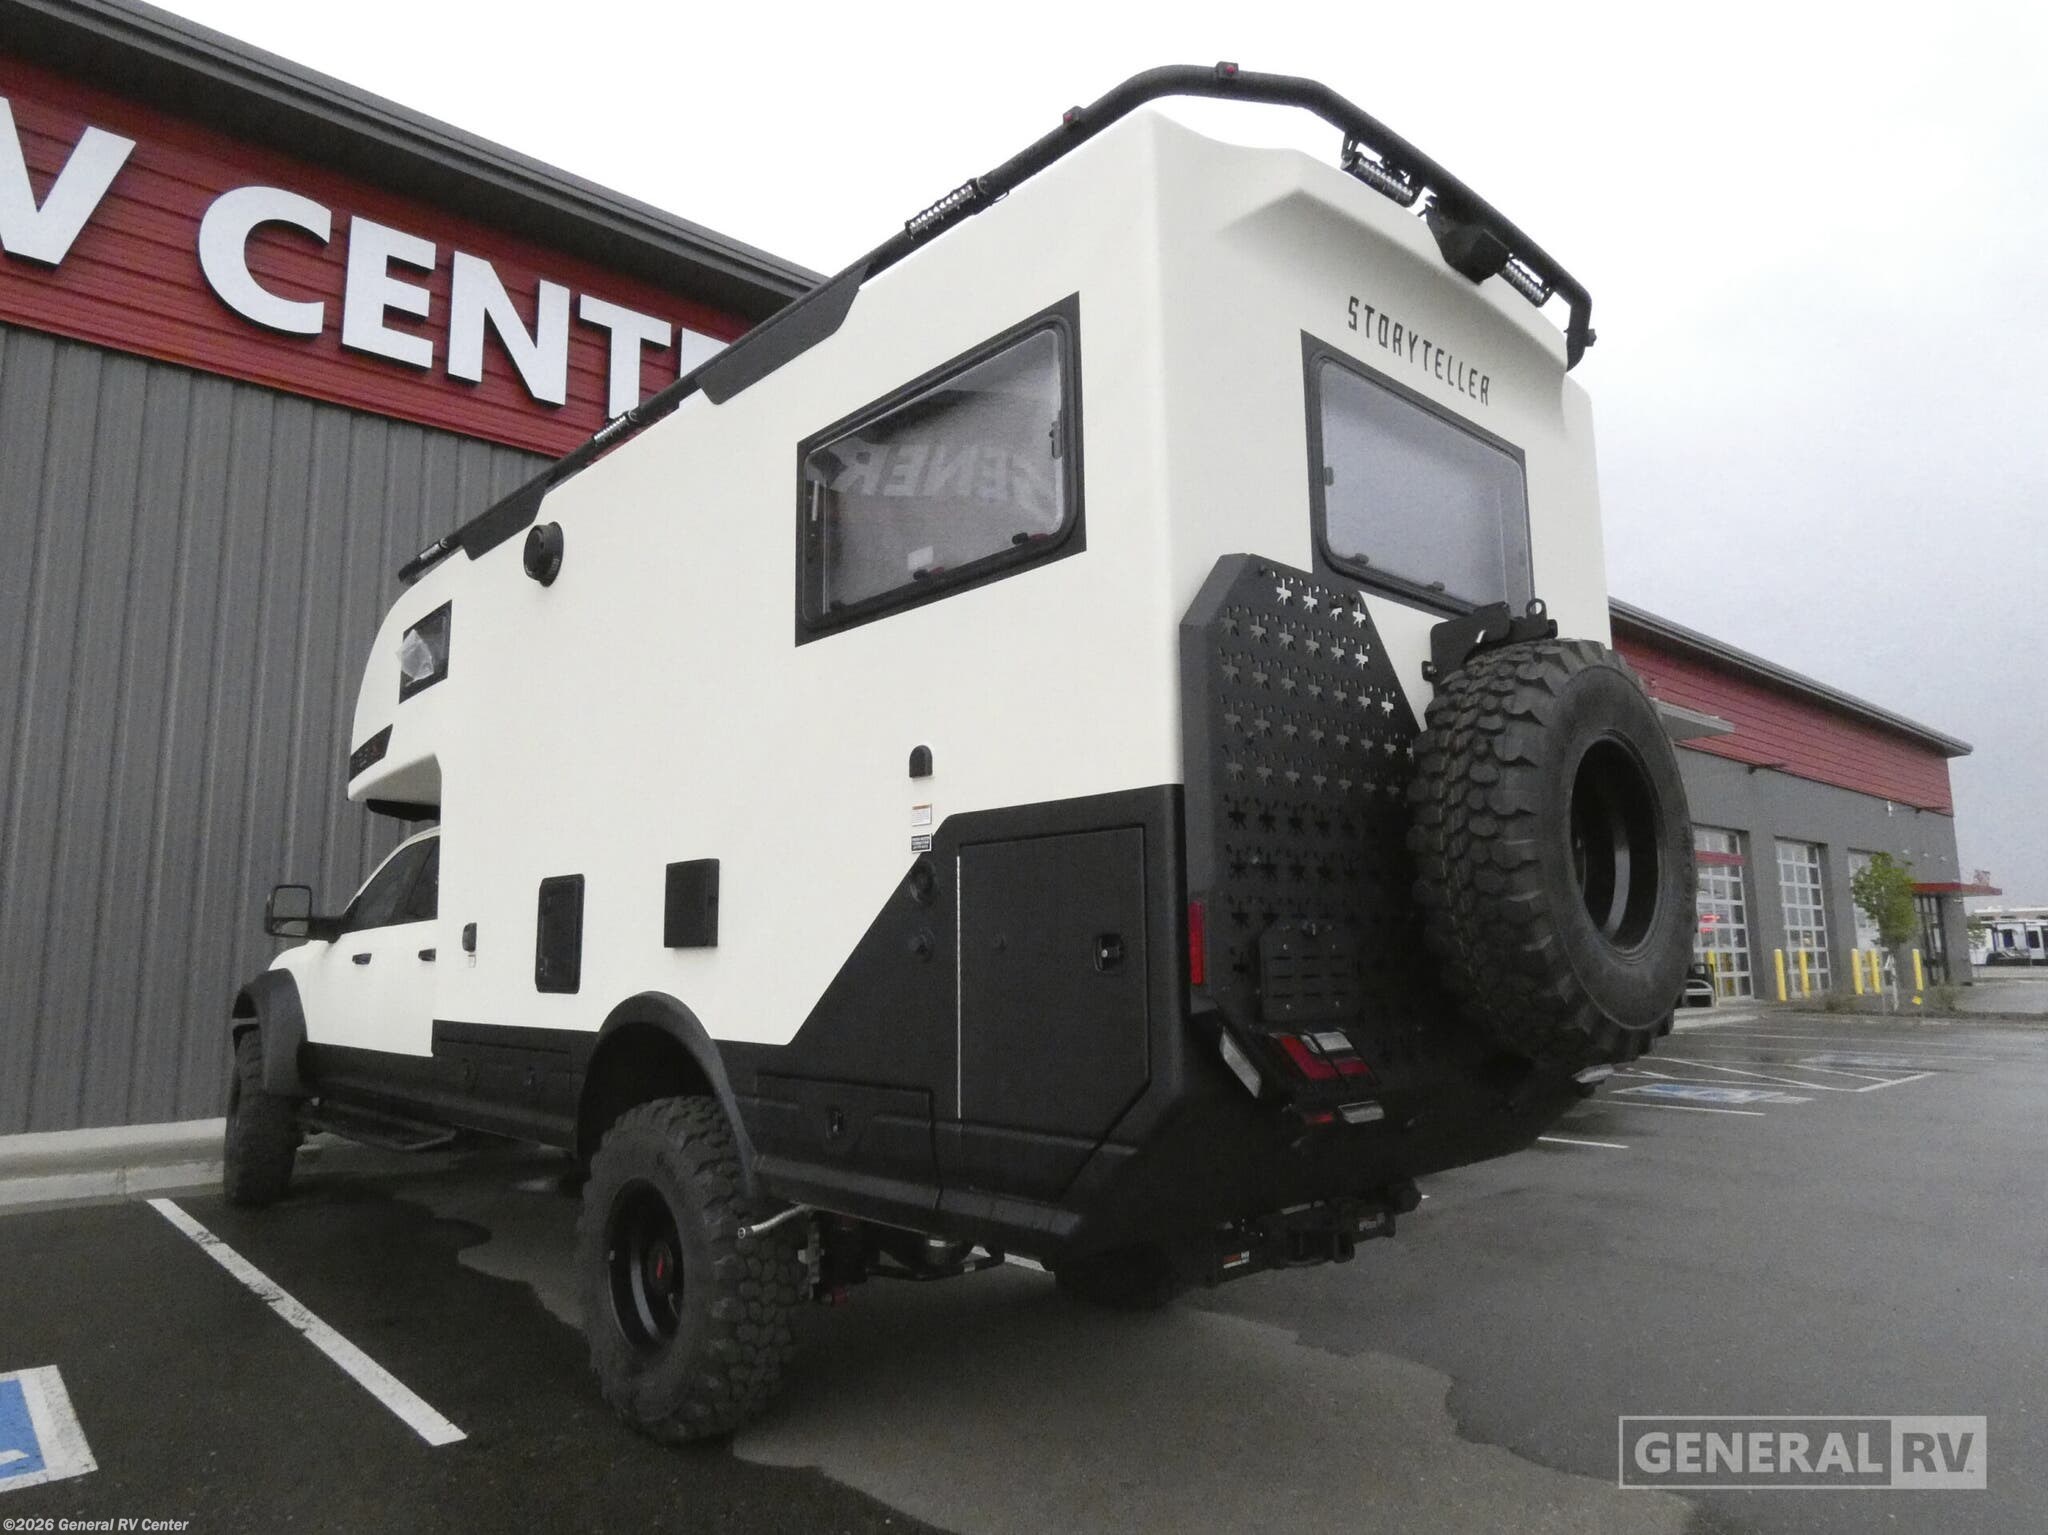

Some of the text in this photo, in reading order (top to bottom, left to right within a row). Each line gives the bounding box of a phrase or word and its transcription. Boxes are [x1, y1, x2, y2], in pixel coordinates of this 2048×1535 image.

[0, 96, 732, 420] V CENT
[1348, 296, 1490, 406] STORYTELLER
